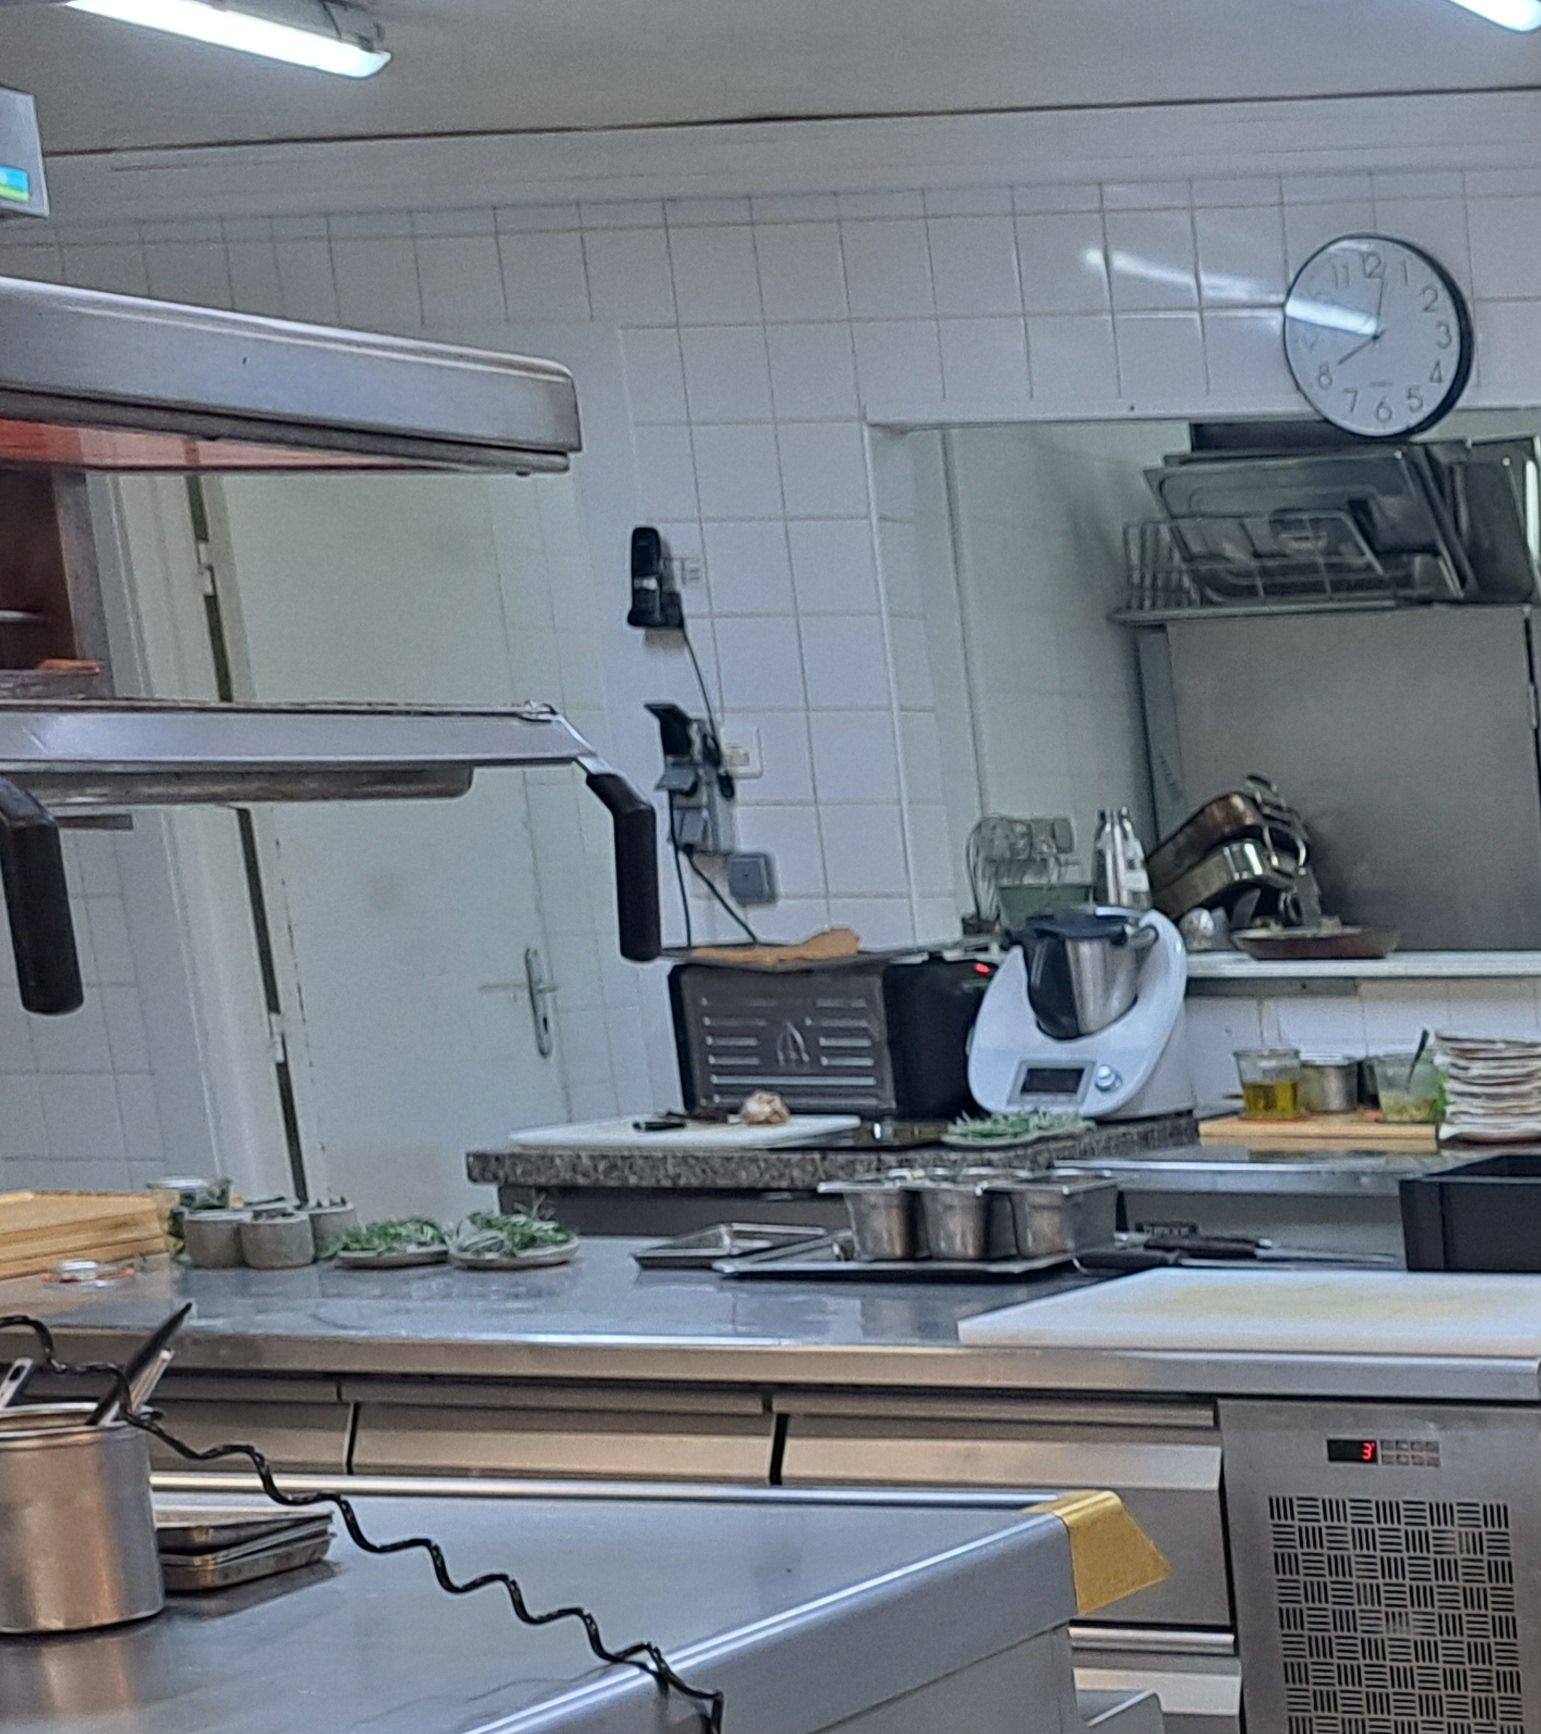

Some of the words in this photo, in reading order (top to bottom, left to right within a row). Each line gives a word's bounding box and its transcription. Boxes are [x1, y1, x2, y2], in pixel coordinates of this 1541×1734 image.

[1331, 263, 1351, 288] 11
[1362, 252, 1382, 280] 12
[1400, 259, 1409, 284] 1
[1420, 286, 1439, 313] 2
[1436, 322, 1452, 349] 3
[1317, 363, 1333, 390] 8
[1429, 361, 1443, 384] 4
[1343, 387, 1359, 413] 7
[1375, 396, 1393, 423] 6
[1405, 385, 1424, 413] 5
